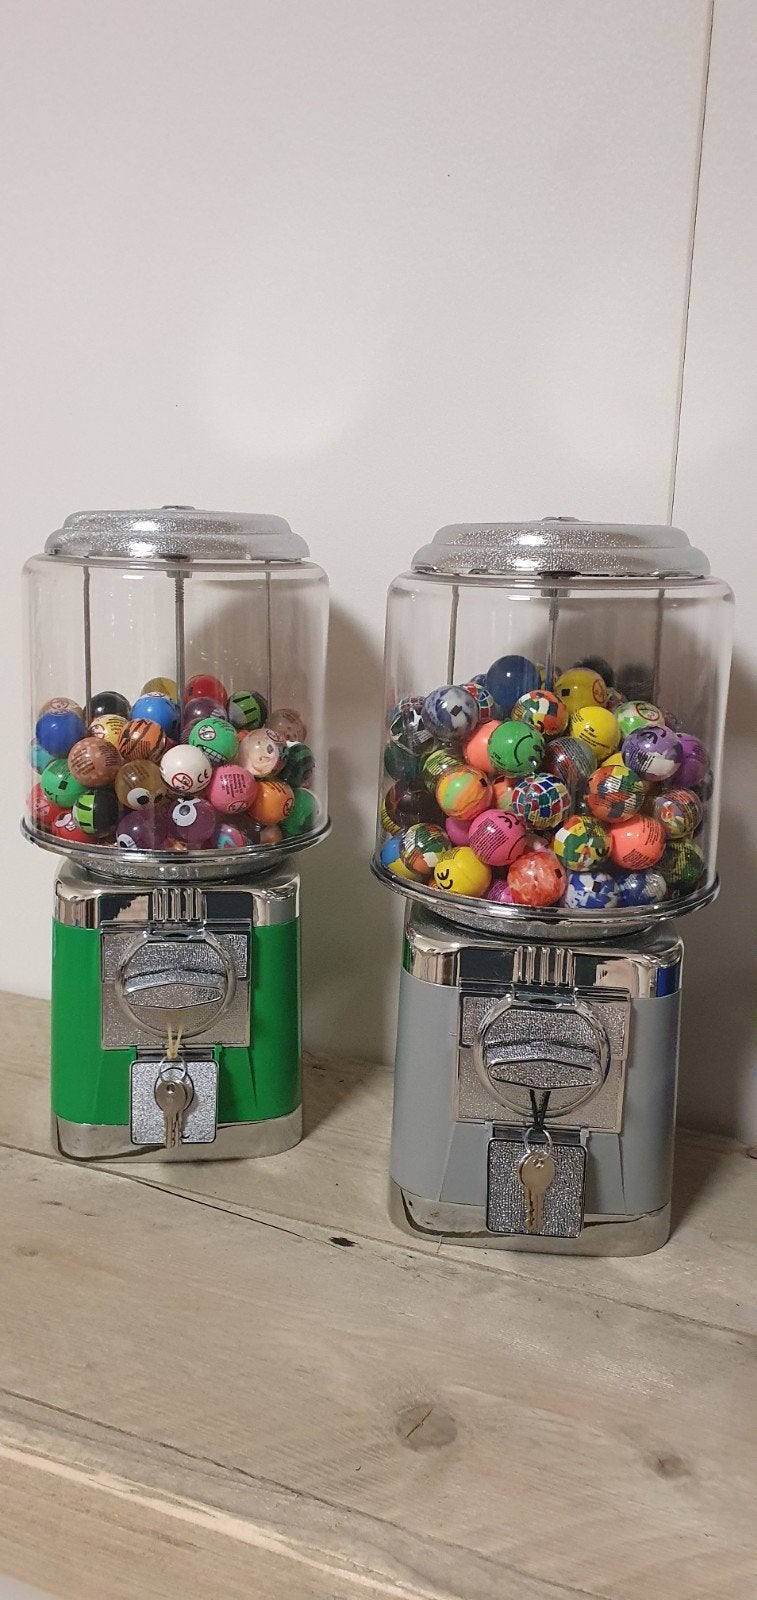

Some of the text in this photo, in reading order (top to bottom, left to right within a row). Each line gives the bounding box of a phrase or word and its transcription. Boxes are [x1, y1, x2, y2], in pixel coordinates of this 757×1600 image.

[197, 769, 209, 783] CE
[497, 812, 520, 829] CE
[437, 869, 454, 890] CE
